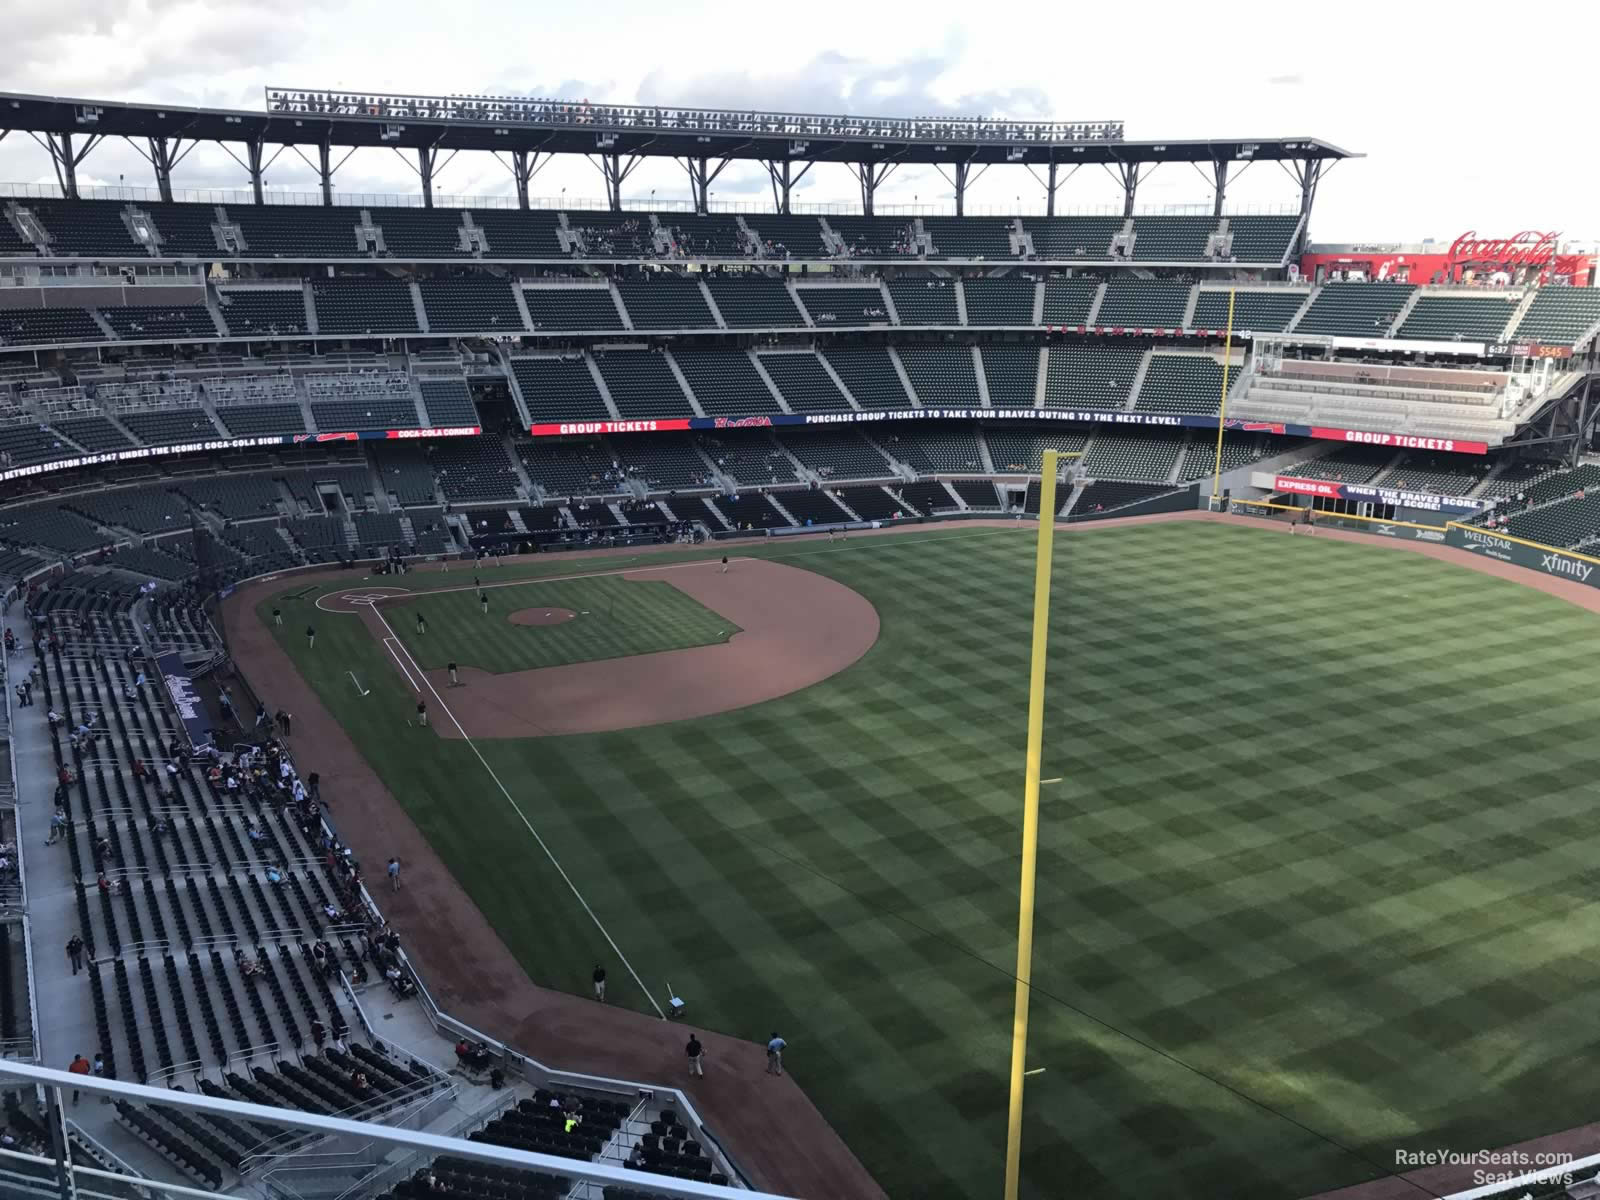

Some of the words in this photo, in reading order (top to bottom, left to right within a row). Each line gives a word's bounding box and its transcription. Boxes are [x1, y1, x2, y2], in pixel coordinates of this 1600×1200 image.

[1448, 230, 1563, 264] Coca-Cola
[1239, 330, 1252, 339] 42
[1489, 345, 1508, 354] 6:37
[806, 412, 853, 423] PURCHASE
[856, 412, 886, 421] GROUP
[889, 411, 925, 419] TICKETS
[1039, 411, 1075, 420] OUTING
[1094, 413, 1113, 421] THE
[1116, 414, 1142, 422] NEXT
[1145, 416, 1181, 425] LEVEL!
[399, 429, 441, 438] COCA-COLA
[444, 428, 475, 437] CORNER
[560, 422, 602, 434] GROUP
[606, 421, 657, 432] TICKETS
[1346, 431, 1390, 444] GROUP
[1395, 436, 1454, 450] TICKETS
[4, 465, 42, 480] BETWEEN
[43, 458, 80, 472] SECTION
[119, 448, 150, 460] UNDER
[152, 446, 170, 456] THE
[171, 443, 203, 454] ICONIC
[204, 439, 256, 450] COCA-COLA
[257, 436, 283, 445] SIGN!
[1278, 480, 1318, 492] EXPRESS
[1319, 485, 1333, 494] OIL
[1347, 485, 1376, 496] WHEN
[1379, 489, 1398, 499] THE
[1401, 492, 1439, 504] BRAVES
[1382, 497, 1402, 506] YOU
[1404, 500, 1440, 510] SCORE!
[1464, 530, 1513, 551] WELLSTAR
[1541, 553, 1593, 581] xfinity
